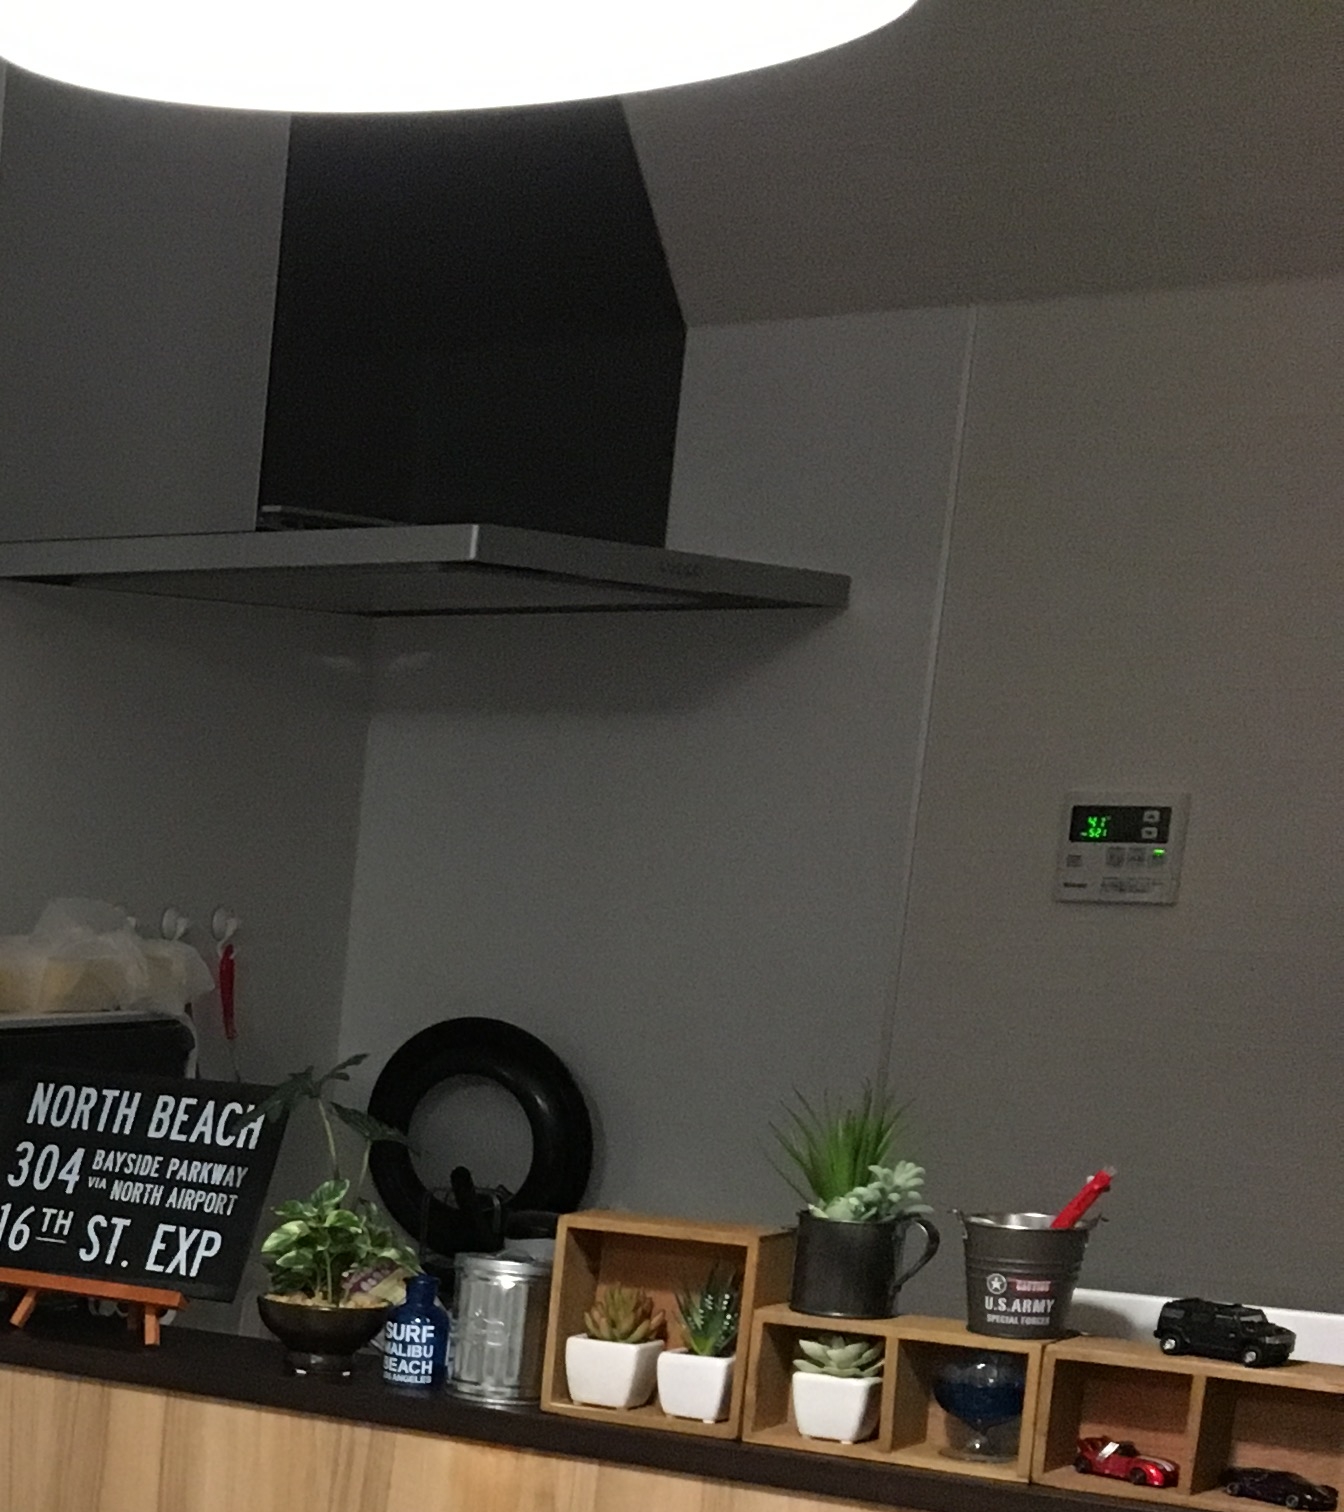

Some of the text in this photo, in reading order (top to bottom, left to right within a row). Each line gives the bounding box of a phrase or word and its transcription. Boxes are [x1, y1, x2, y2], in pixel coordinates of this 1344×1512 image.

[26, 1082, 265, 1150] NORTH BEACH
[7, 1141, 85, 1194] 304
[92, 1150, 248, 1188] BAYSIDE PARKWAY
[88, 1176, 238, 1216] VIA NORTH AIRPORT
[79, 1214, 131, 1268] ST.
[145, 1223, 222, 1278] EXP
[385, 1321, 435, 1343] SURF
